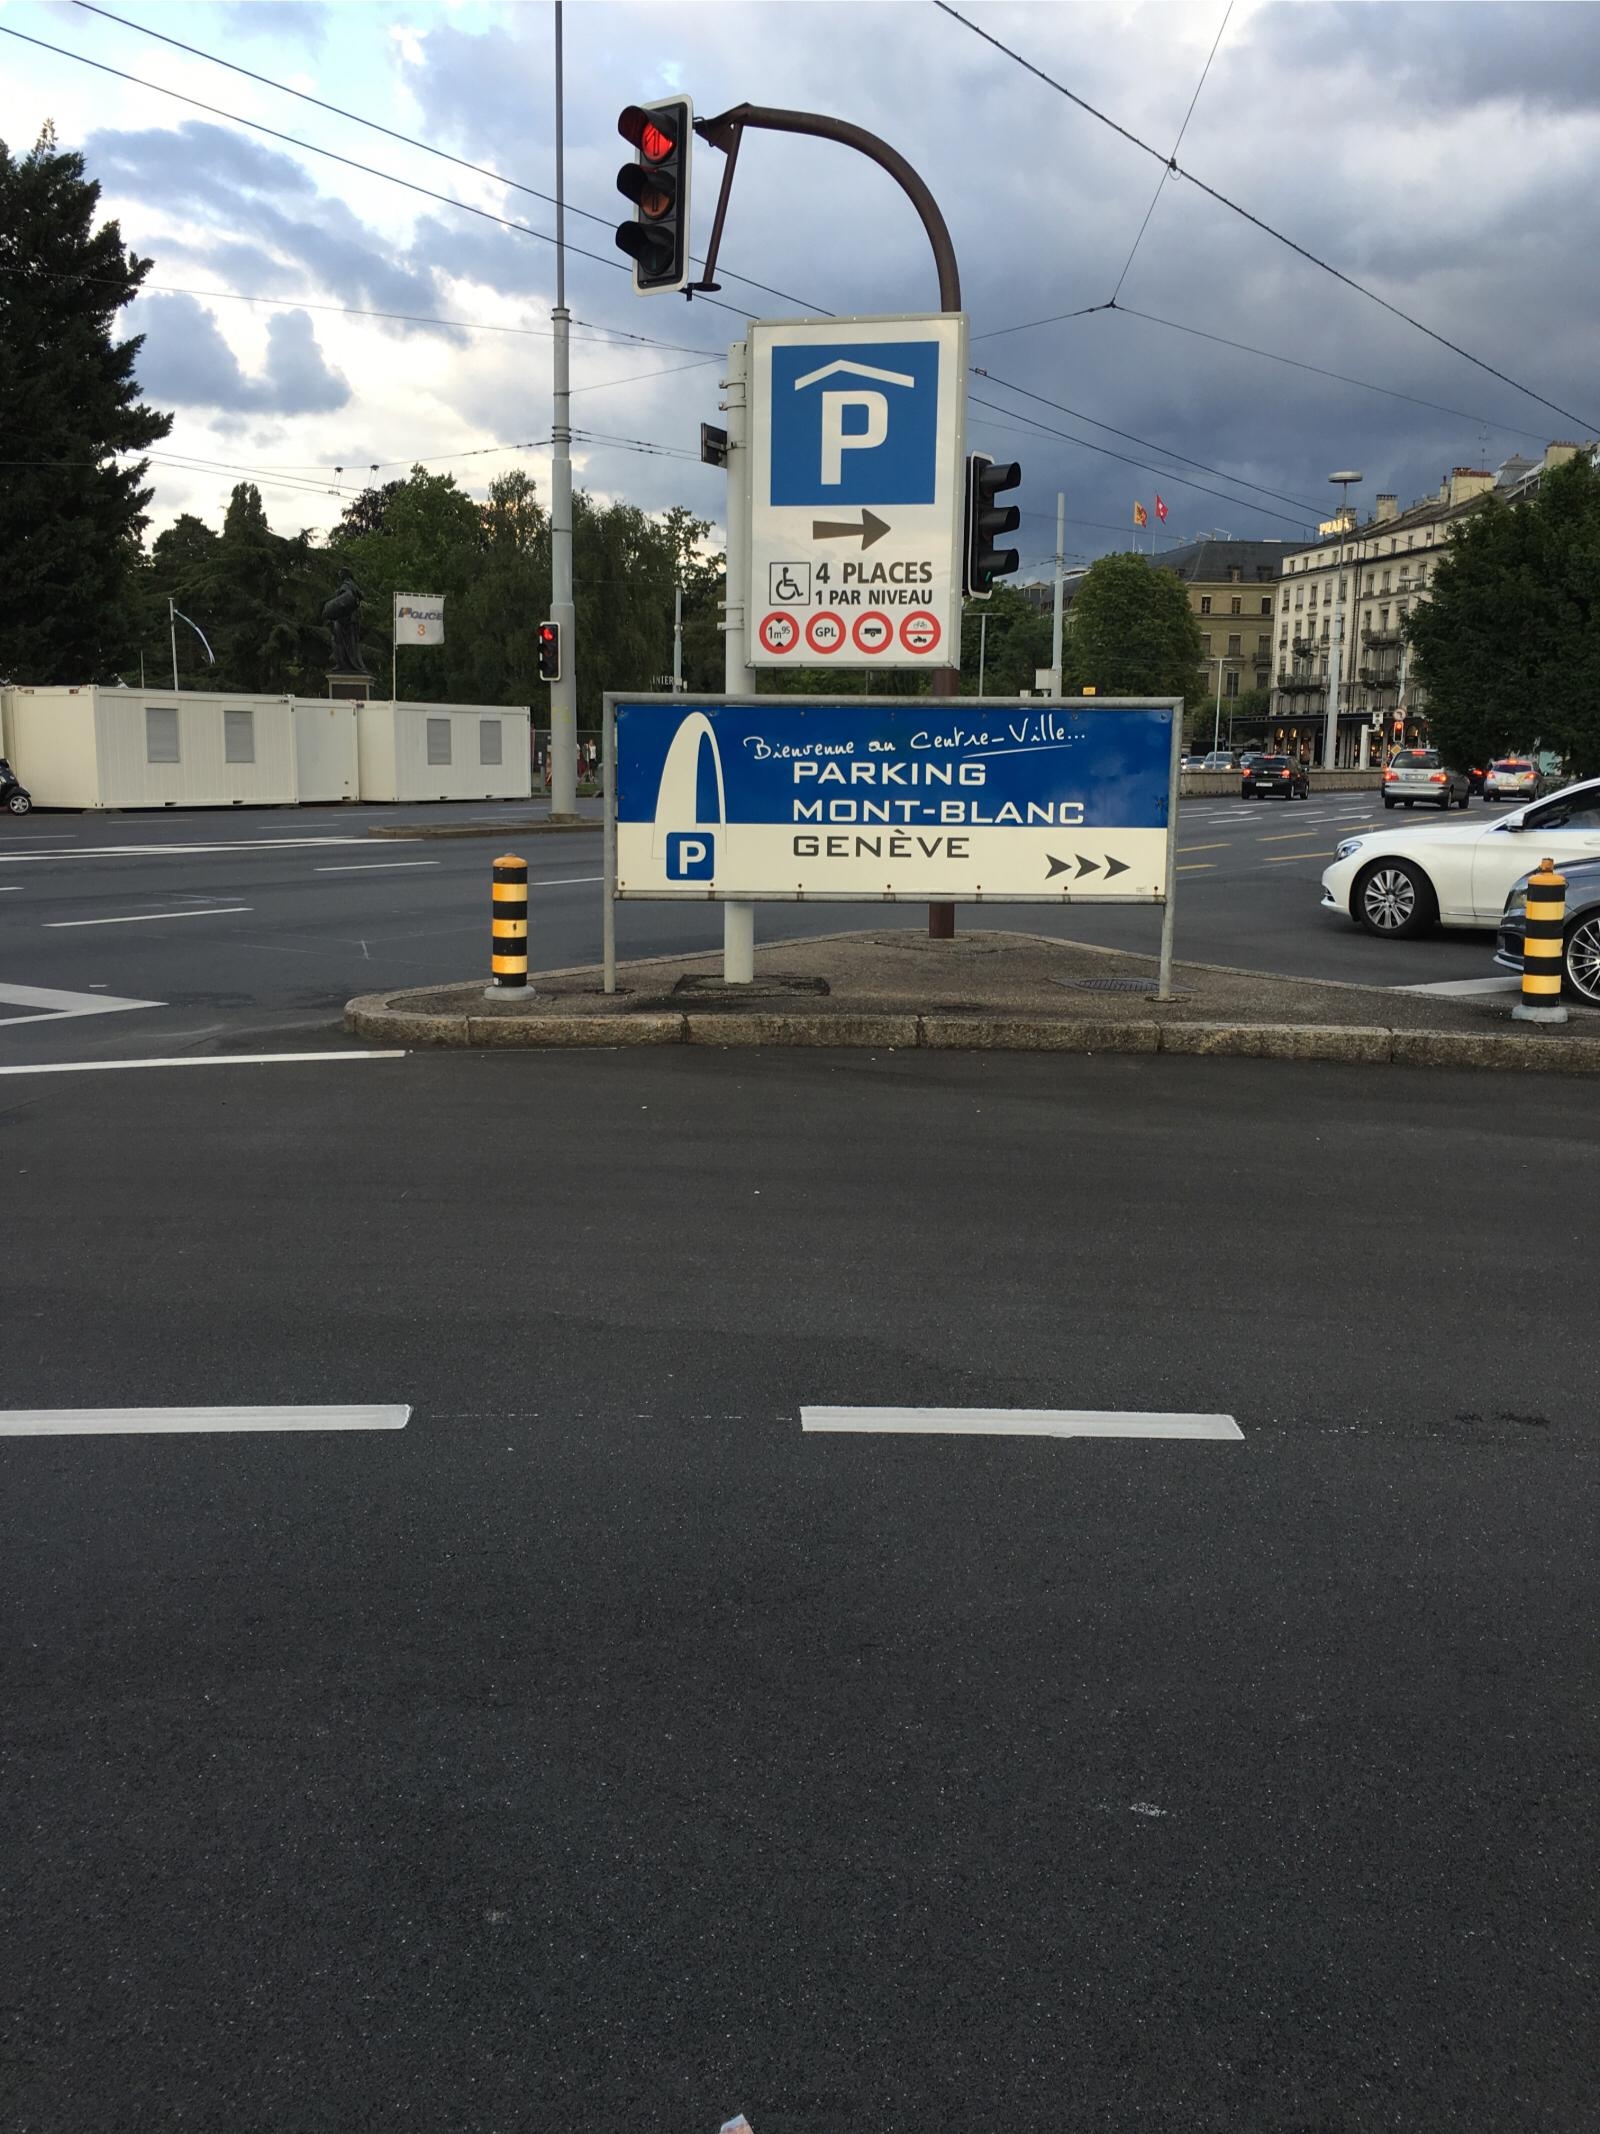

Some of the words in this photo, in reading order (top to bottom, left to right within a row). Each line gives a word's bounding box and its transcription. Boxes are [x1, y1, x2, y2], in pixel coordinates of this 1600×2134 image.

[821, 390, 888, 485] P
[815, 563, 830, 584] 4
[843, 561, 933, 584] PLACES
[815, 591, 822, 605] 1
[829, 590, 861, 606] PAR
[868, 589, 933, 606] NIVEAU
[398, 607, 443, 620] POLICE
[417, 624, 426, 636] 3
[815, 627, 836, 638] GPL
[793, 761, 987, 786] PARKING
[793, 799, 1085, 825] MONT-BLANC
[793, 829, 970, 858] GENÈVE
[678, 840, 707, 874] P
